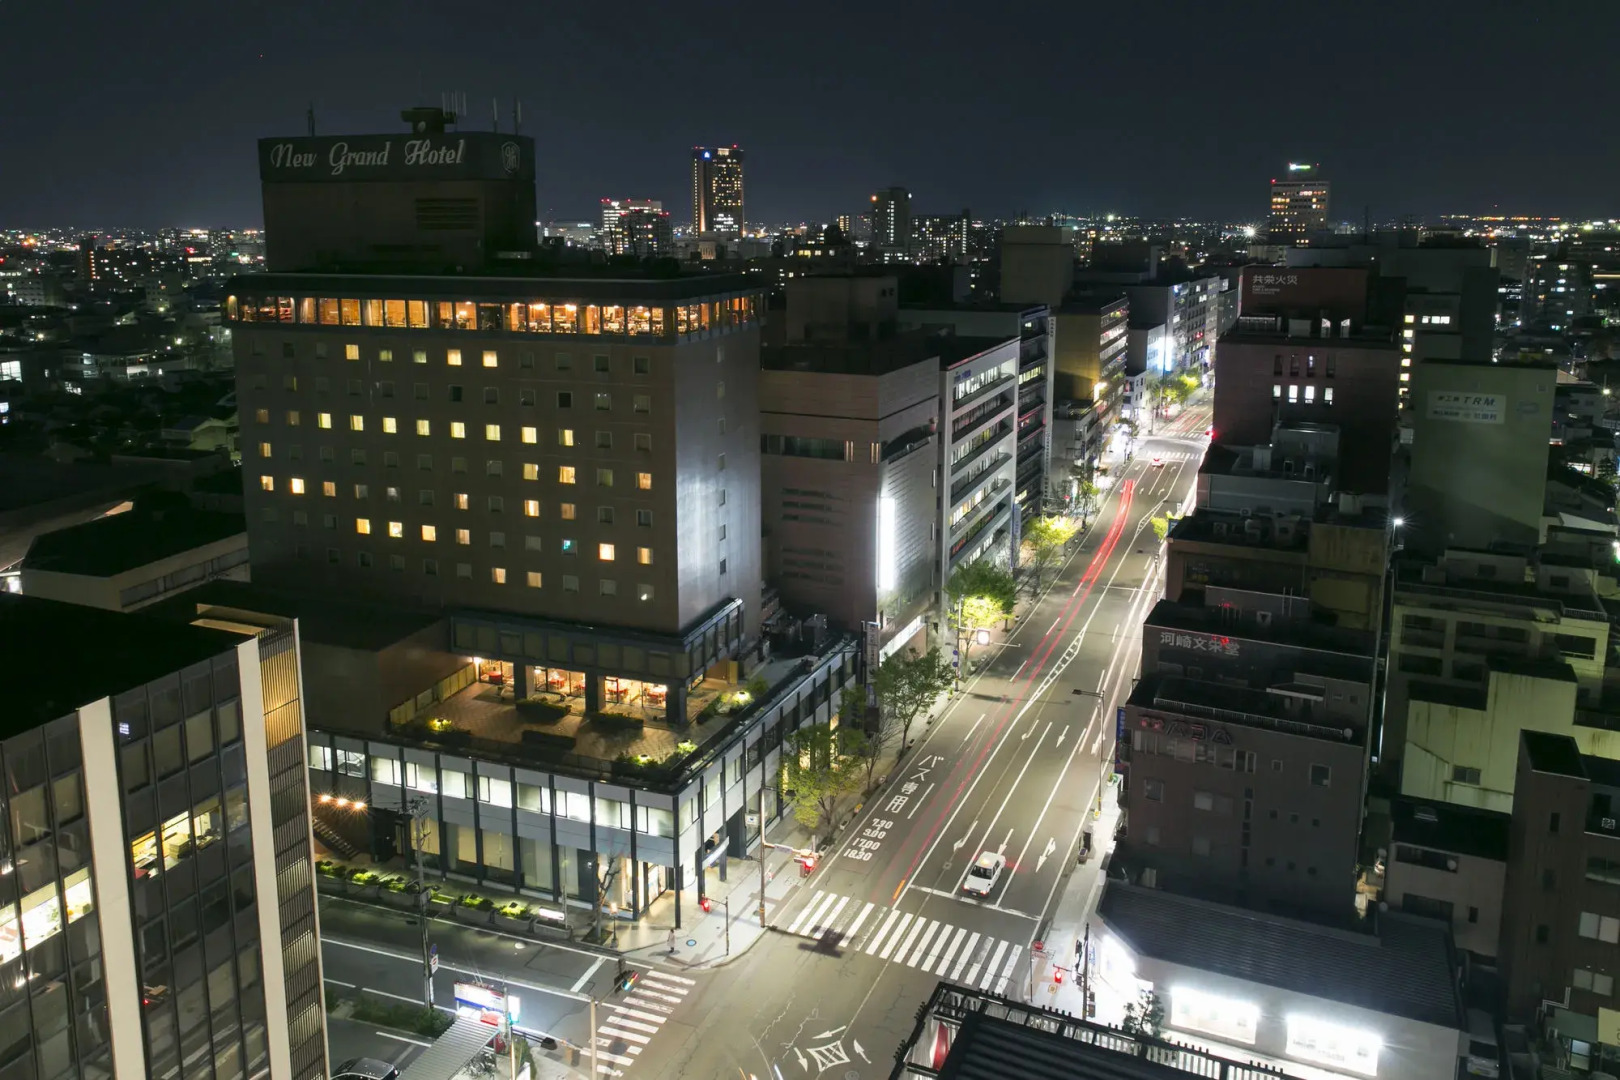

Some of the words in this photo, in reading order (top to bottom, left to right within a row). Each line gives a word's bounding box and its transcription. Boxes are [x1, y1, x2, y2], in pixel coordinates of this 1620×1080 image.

[270, 144, 317, 168] New
[329, 141, 391, 175] Grand
[404, 139, 466, 166] Hotel
[1252, 274, 1298, 285] 共栄火災
[884, 755, 944, 813] バス専用
